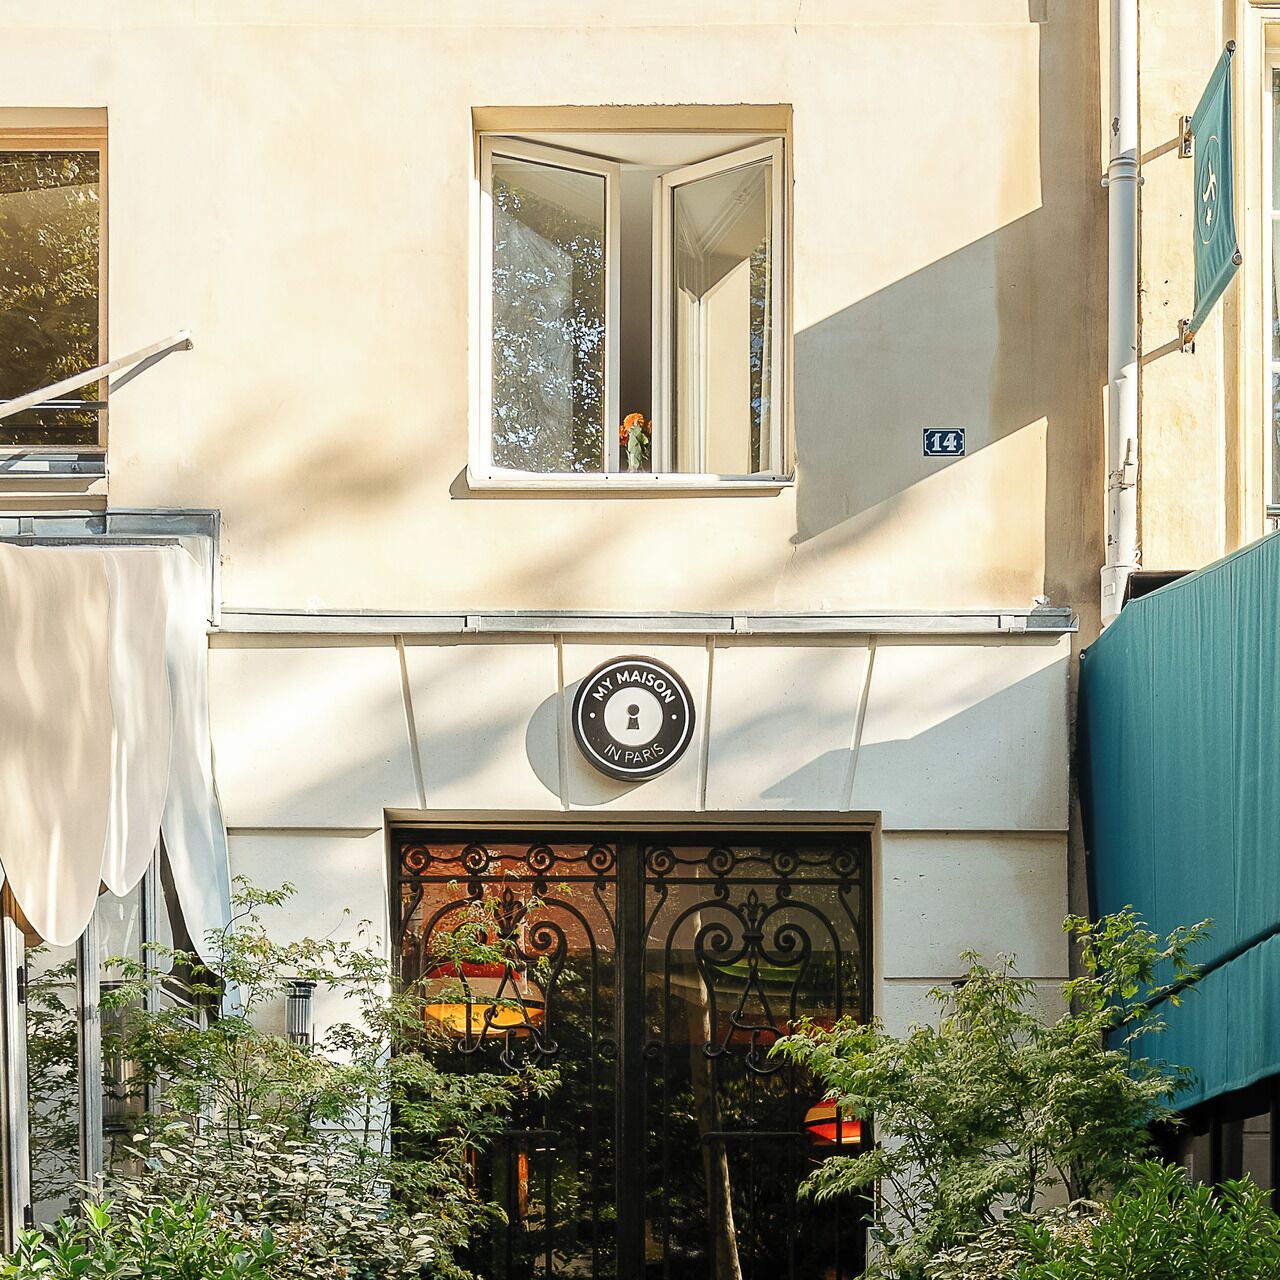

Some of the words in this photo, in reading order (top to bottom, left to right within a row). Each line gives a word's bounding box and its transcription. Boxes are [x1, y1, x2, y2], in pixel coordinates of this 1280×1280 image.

[931, 433, 957, 451] 14
[592, 677, 614, 702] MY
[616, 670, 676, 704] MAISON
[603, 743, 622, 761] IN
[624, 743, 665, 764] PARIS
